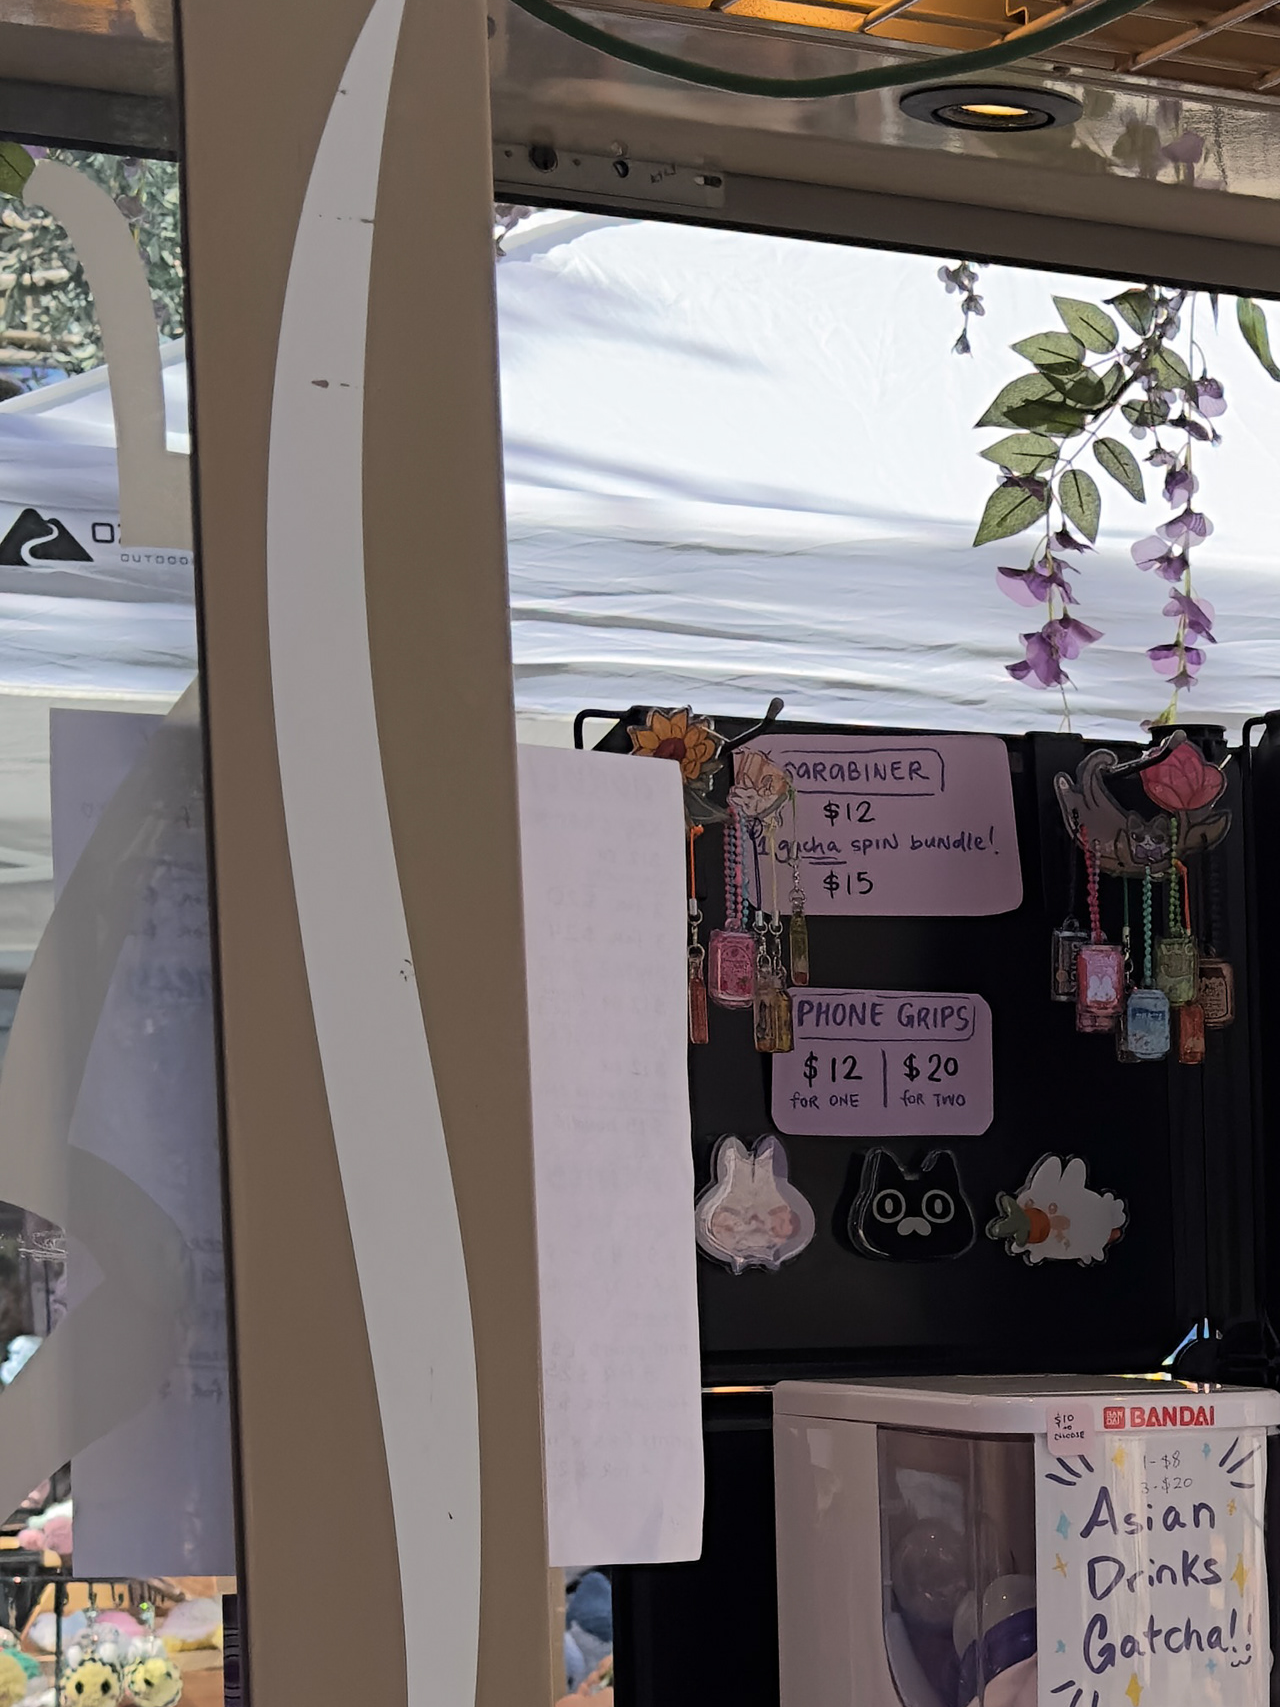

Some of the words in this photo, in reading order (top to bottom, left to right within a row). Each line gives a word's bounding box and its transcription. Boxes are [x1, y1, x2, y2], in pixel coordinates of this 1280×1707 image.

[121, 553, 195, 565] OUTDOO
[823, 800, 875, 827] $12
[823, 870, 874, 899] $15
[797, 999, 885, 1027] PHONE
[897, 1002, 970, 1031] GRIPS
[829, 1094, 860, 1108] ONE
[933, 1092, 966, 1107] TWO
[1130, 1406, 1214, 1427] BANDAI
[1079, 1486, 1216, 1538] Asian
[1087, 1549, 1223, 1600] Drinks
